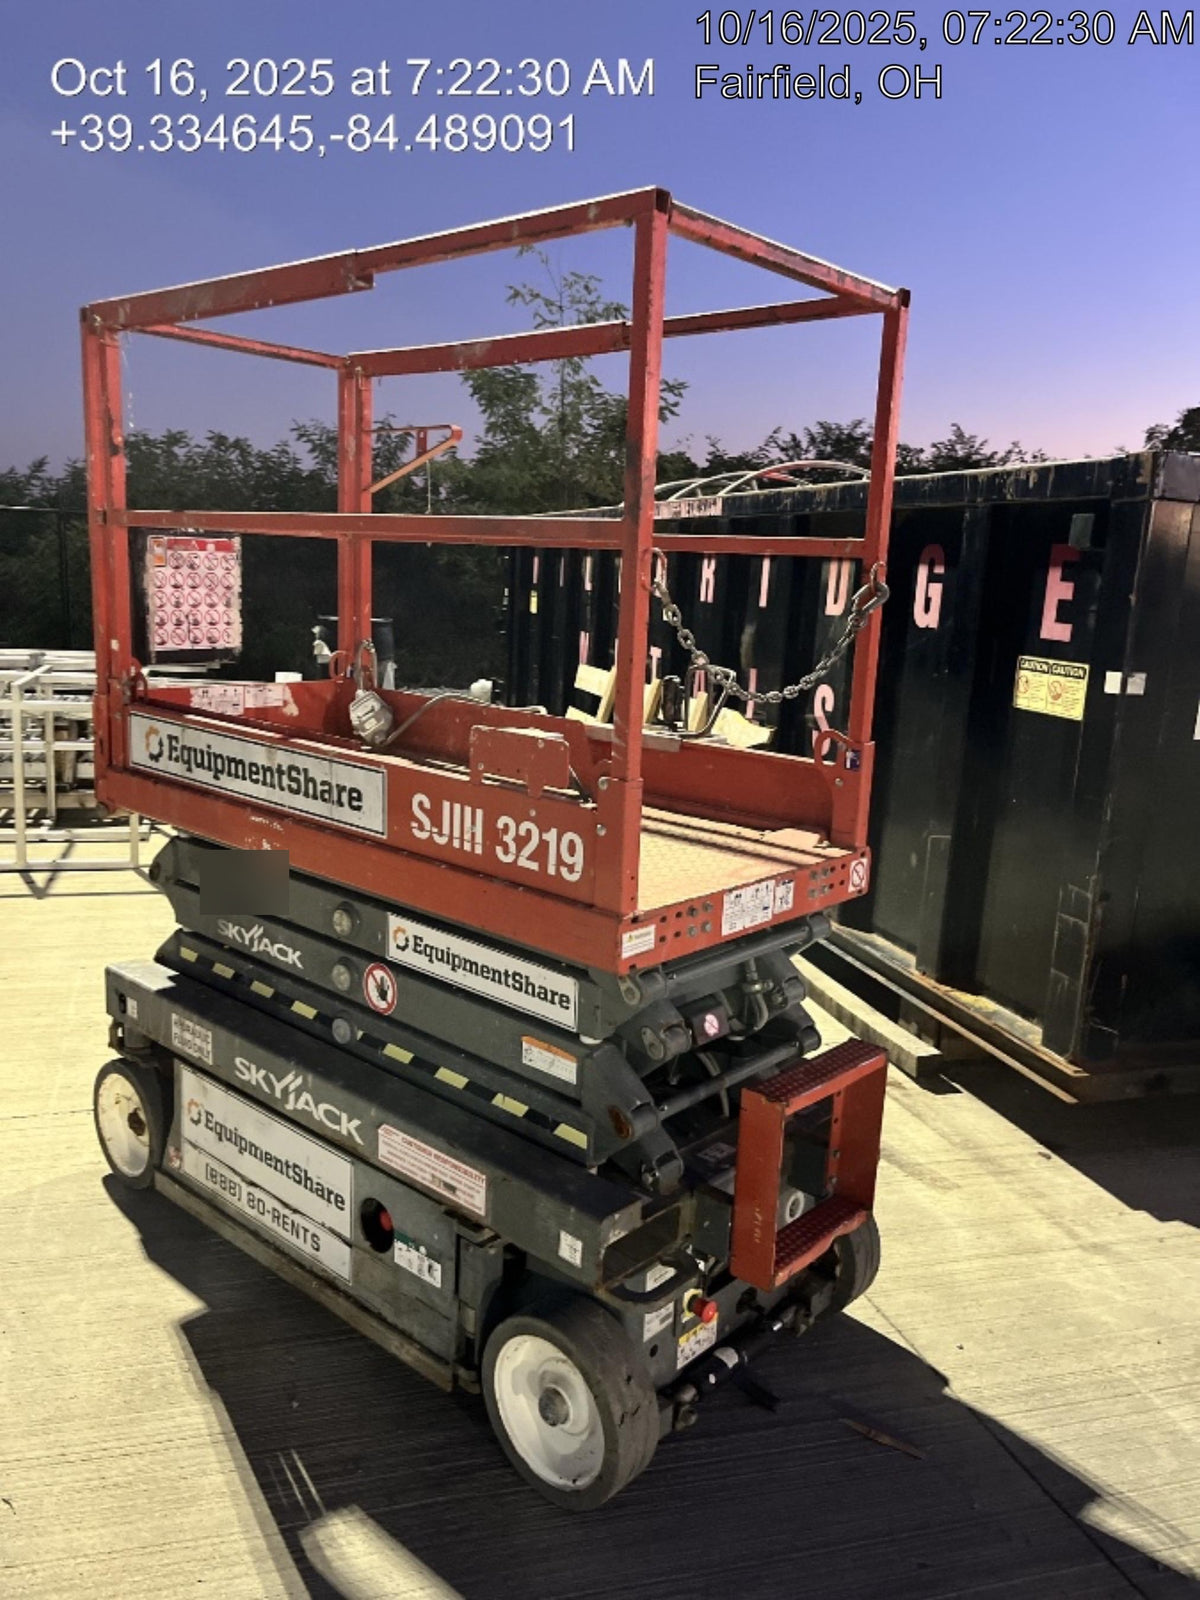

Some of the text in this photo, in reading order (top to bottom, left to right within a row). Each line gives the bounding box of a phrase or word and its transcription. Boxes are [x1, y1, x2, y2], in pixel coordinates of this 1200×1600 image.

[166, 733, 364, 812] EquipmentShare
[495, 815, 584, 882] 3219
[217, 919, 304, 970] SKYJACK
[412, 934, 571, 1011] EquipmentShare
[234, 1057, 364, 1146] SKYJACK
[203, 1109, 346, 1213] EquipmentShare
[246, 1190, 322, 1253] 80-RENTS
